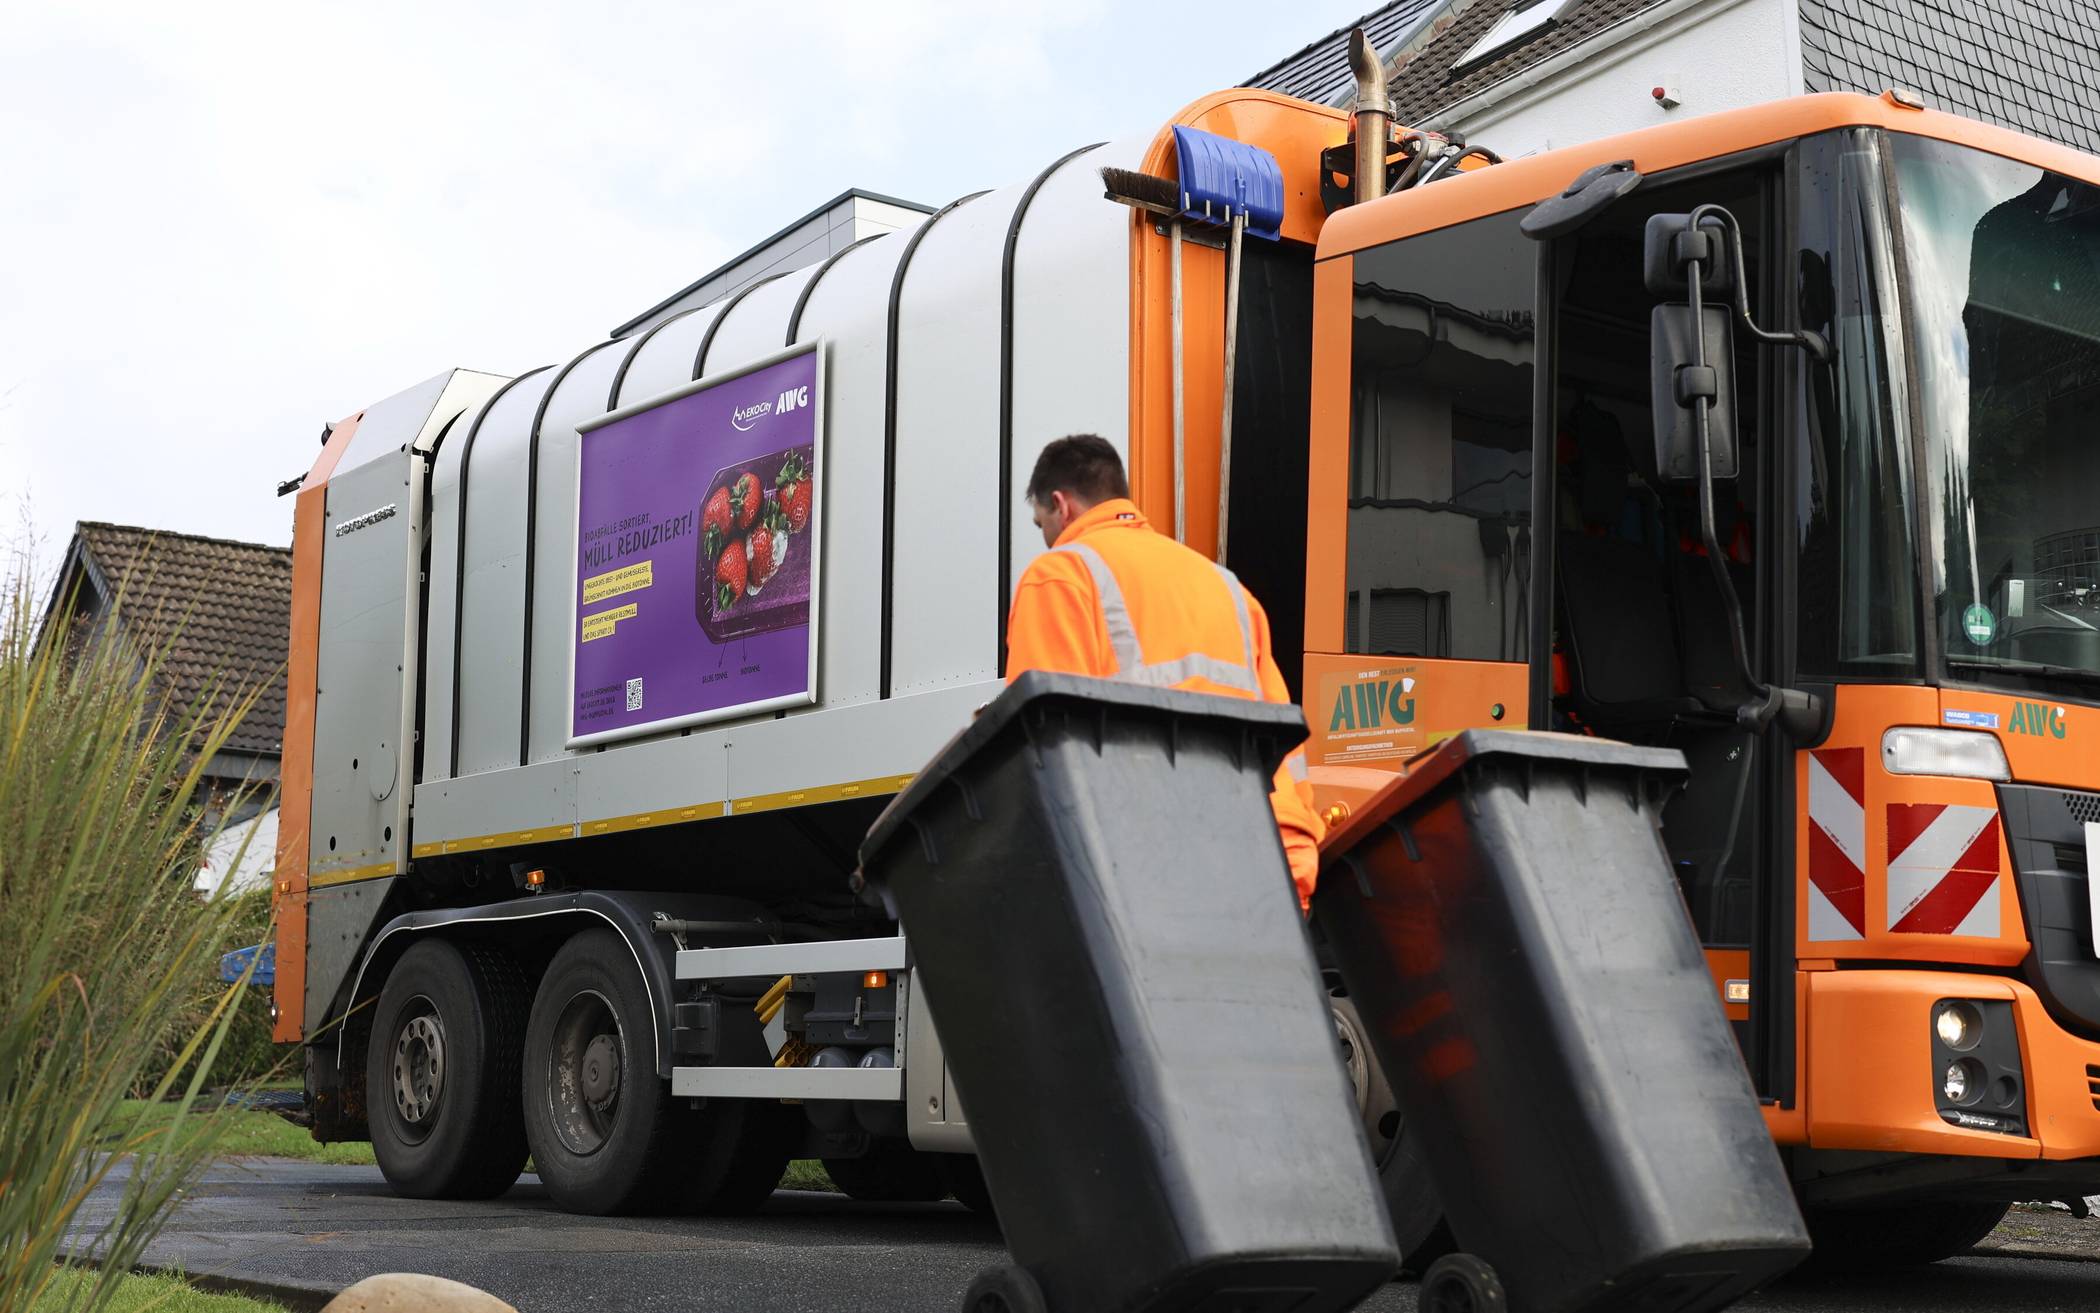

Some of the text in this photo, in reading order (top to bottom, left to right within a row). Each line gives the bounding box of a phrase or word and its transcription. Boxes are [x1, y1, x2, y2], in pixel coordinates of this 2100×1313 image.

[775, 386, 808, 415] AWG
[584, 510, 693, 571] MÜLL REDUZIERT!
[1329, 677, 1416, 731] AWG
[2008, 702, 2066, 739] AWG
